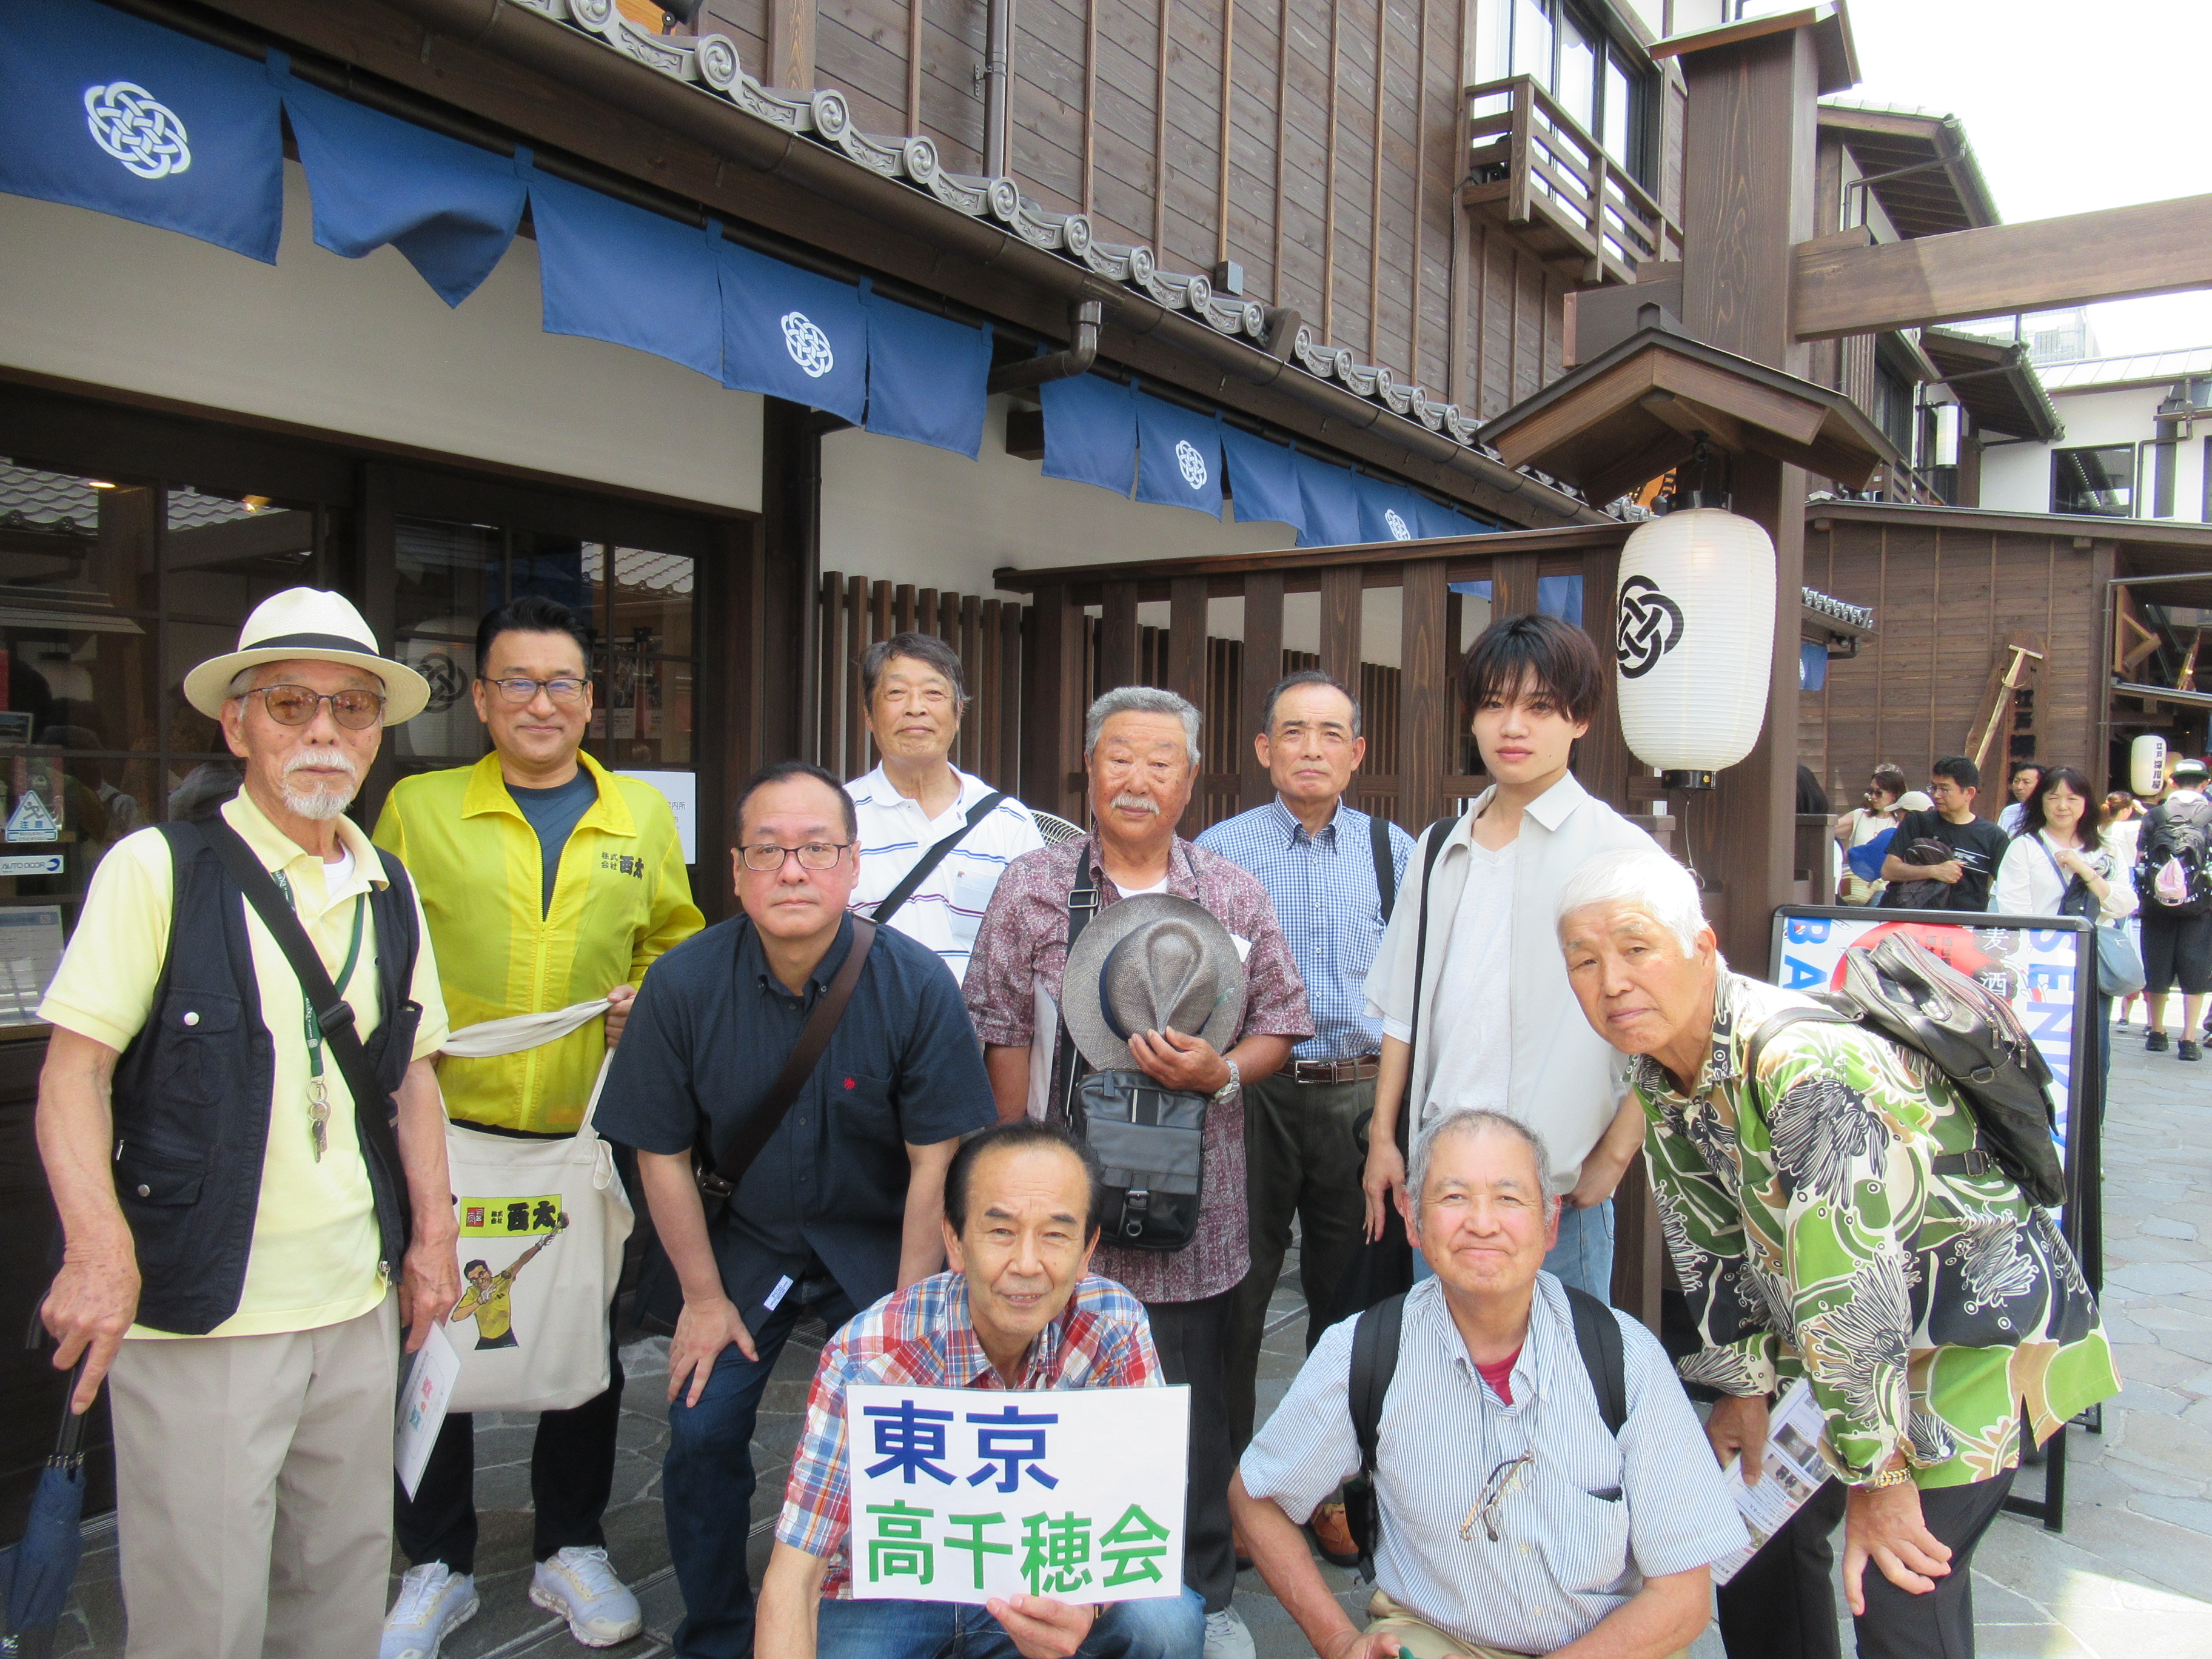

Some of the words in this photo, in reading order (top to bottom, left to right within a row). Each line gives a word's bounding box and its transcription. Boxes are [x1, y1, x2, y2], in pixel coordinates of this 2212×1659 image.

[771, 1284, 782, 1298] POLO
[863, 1399, 1059, 1493] 東京
[866, 1499, 1171, 1597] 高千穂会
